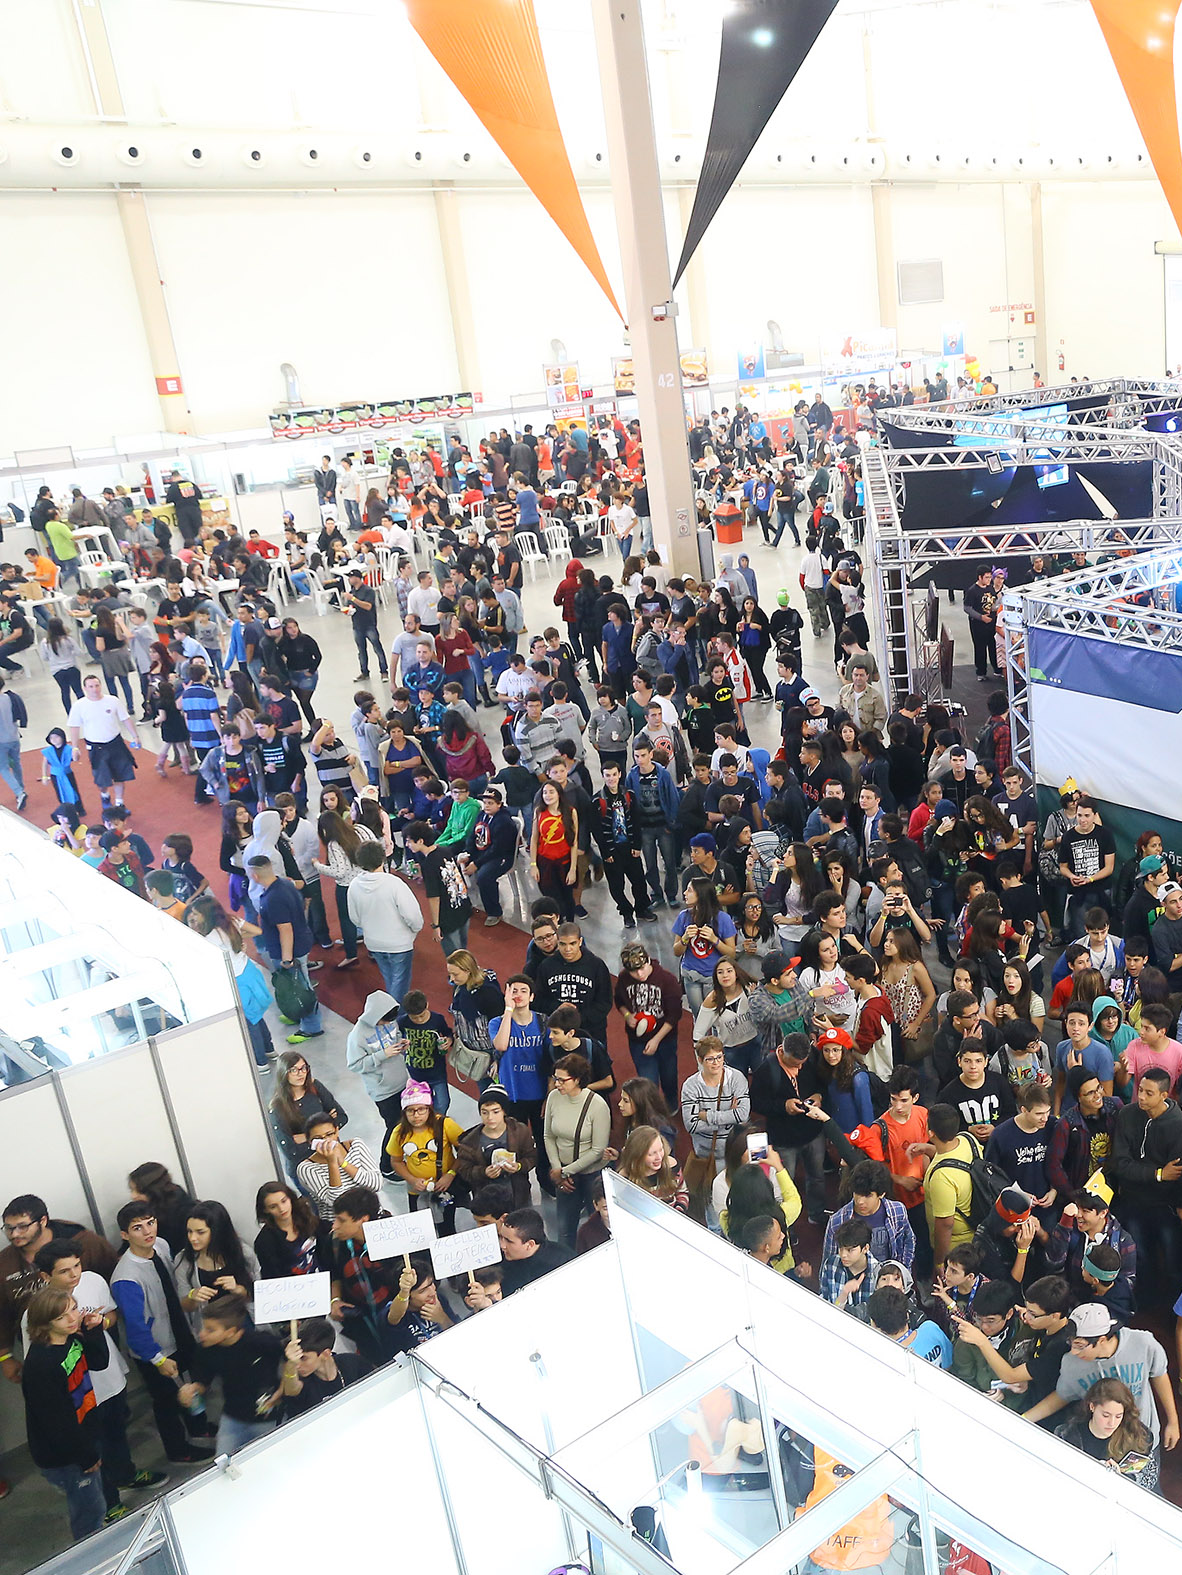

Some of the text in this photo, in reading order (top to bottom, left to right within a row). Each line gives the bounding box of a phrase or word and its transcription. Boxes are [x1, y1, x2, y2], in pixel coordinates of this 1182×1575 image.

[166, 380, 179, 391] E
[658, 373, 674, 387] 42
[510, 1034, 543, 1049] OLLISTE
[413, 1058, 435, 1069] KID
